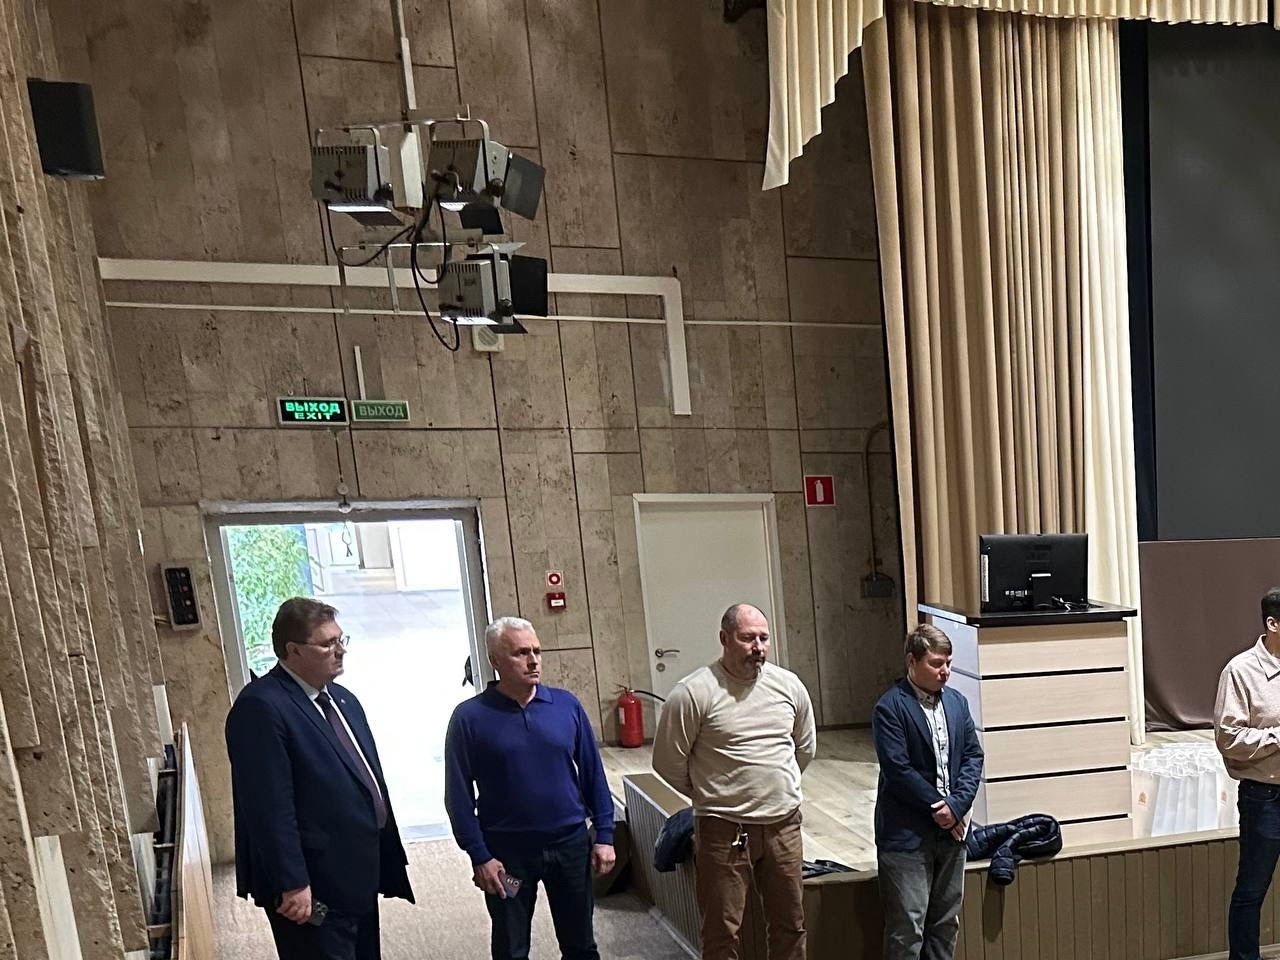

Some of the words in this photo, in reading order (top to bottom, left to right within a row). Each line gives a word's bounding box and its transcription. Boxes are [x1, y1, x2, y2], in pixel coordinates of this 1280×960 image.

[285, 402, 340, 414] ВЫХОД
[359, 405, 404, 418] ВЫХОД
[294, 412, 333, 420] EXIT
